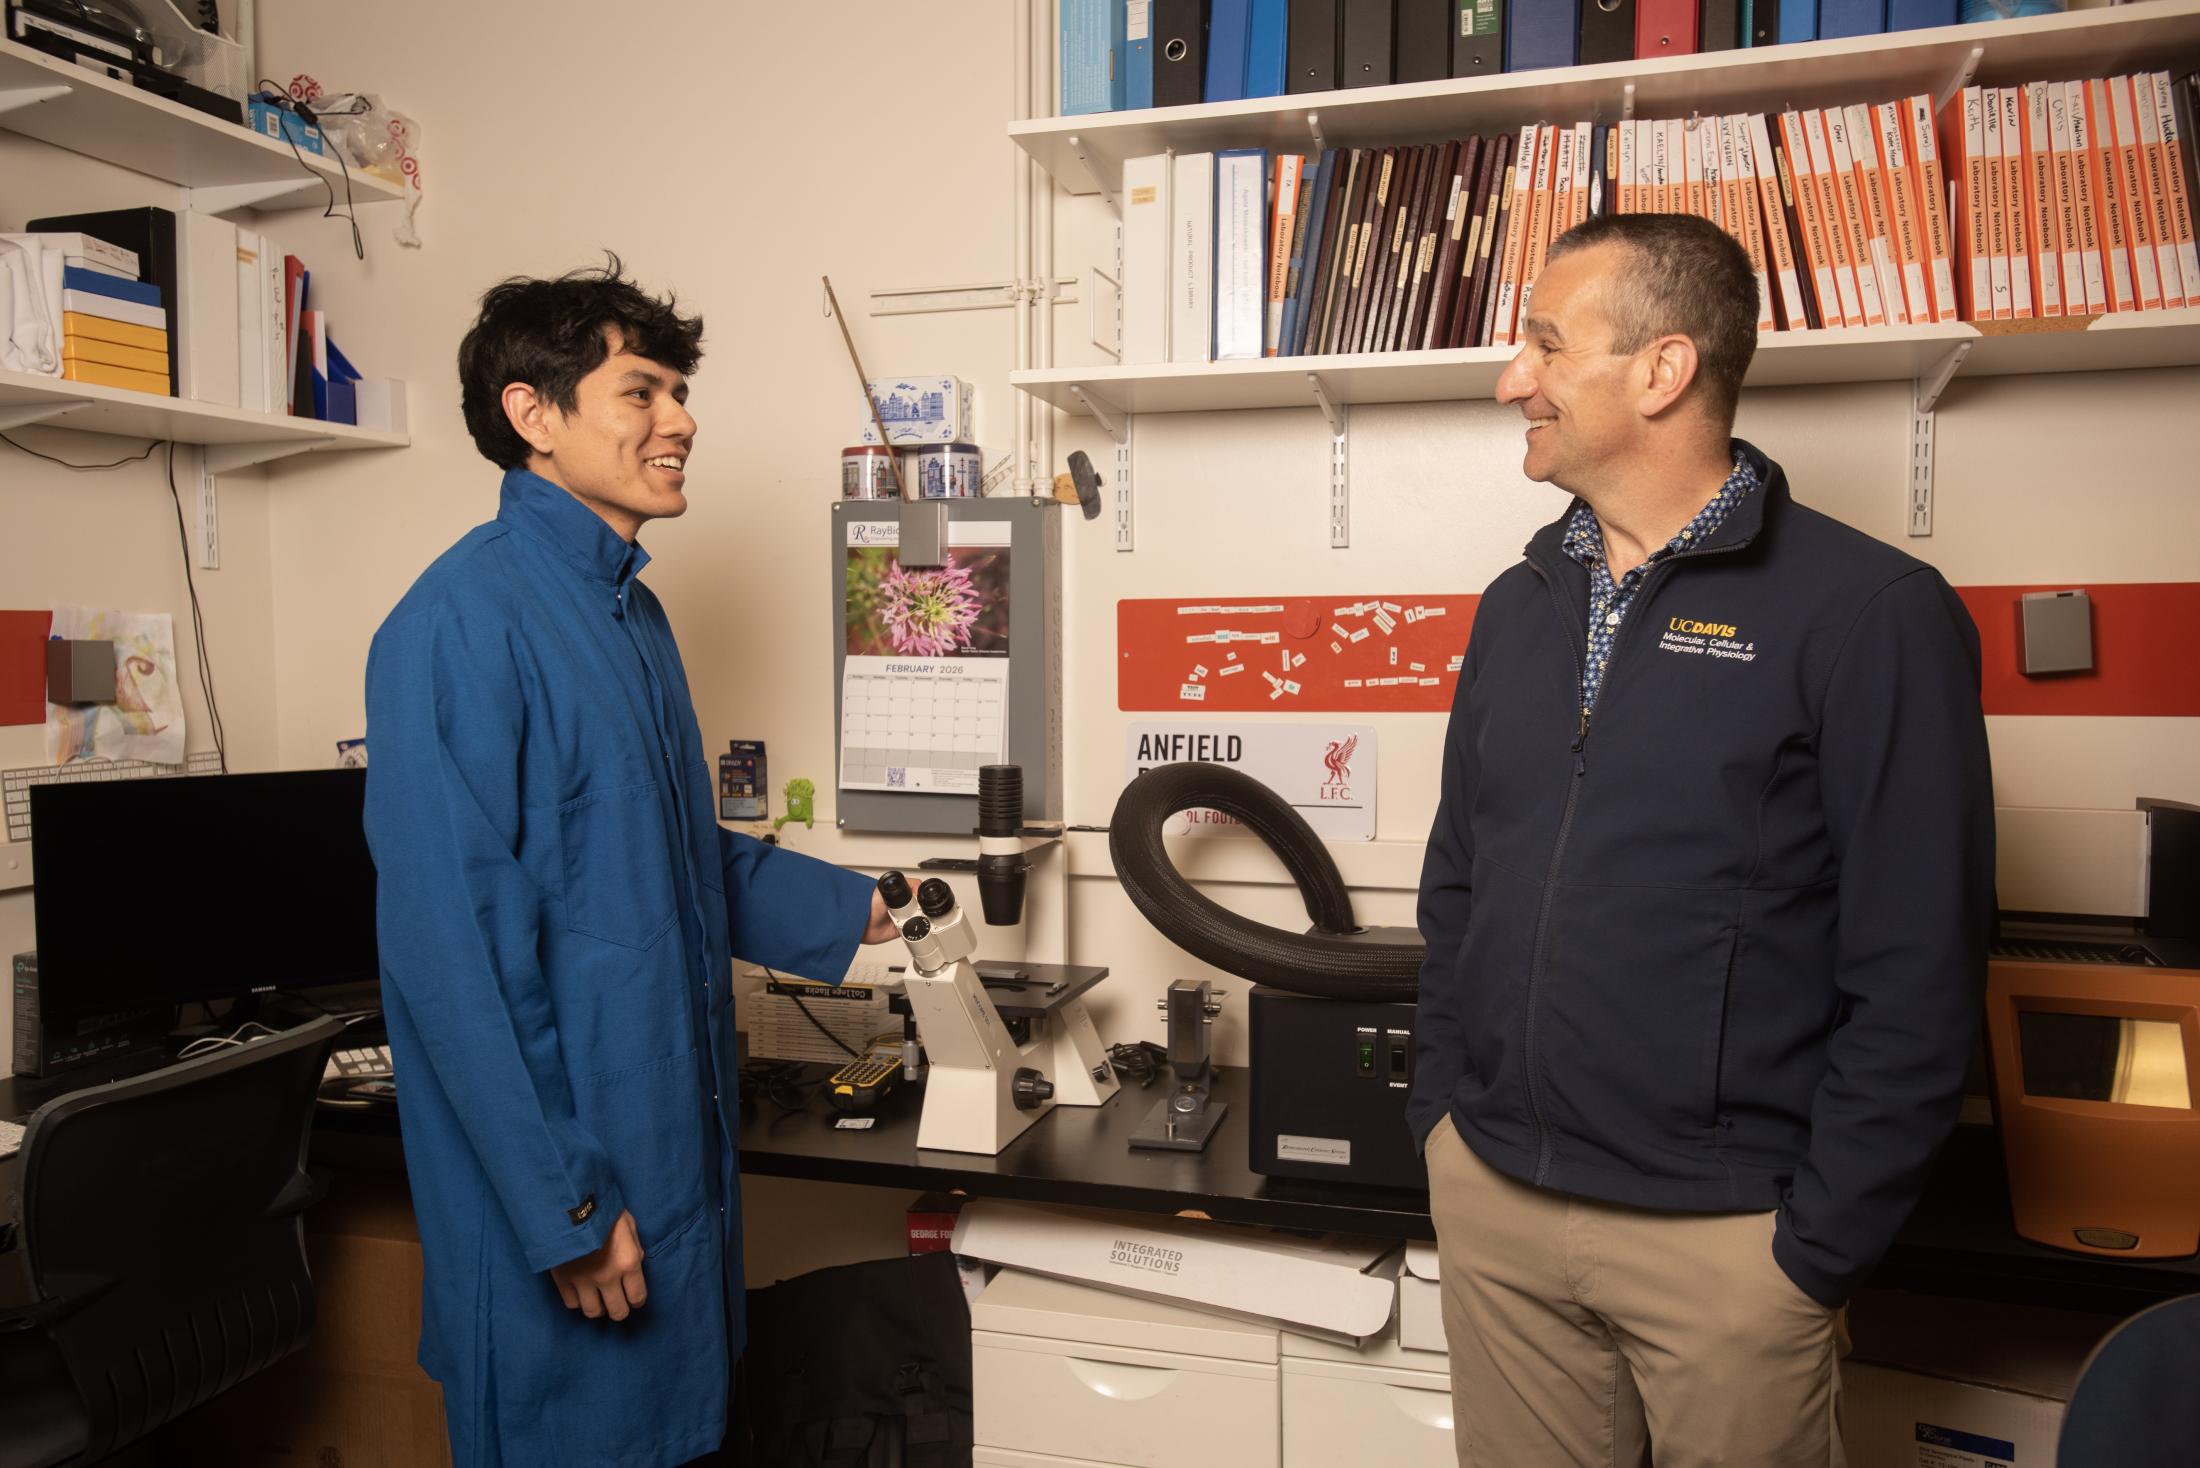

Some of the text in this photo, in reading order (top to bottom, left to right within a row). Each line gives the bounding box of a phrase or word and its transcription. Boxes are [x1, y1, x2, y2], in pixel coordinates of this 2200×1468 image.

[2052, 99, 2064, 132] Chris
[1728, 183, 1739, 228] Laboratory
[1745, 181, 1756, 227] Laboratory
[1766, 181, 1790, 267] Laboratory Notebook
[1801, 178, 1825, 265] Laboratory Notebook
[1822, 177, 1845, 264] Laboratory Notebook
[1843, 175, 1867, 263] Laboratory Notebook
[1868, 172, 1882, 218] Laboratory
[1894, 172, 1914, 261] Laboratory Notebook
[1925, 165, 1944, 256] Laboratory Notebook
[1972, 160, 1983, 254] Laboratory Notebook
[1990, 161, 1999, 207] Laboratory
[2010, 160, 2022, 253] Laboratory Notebook
[2037, 155, 2051, 249] Laboratory Notebook
[2059, 155, 2074, 249] Laboratory Notebook
[2077, 154, 2094, 248] Laboratory Notebook
[2103, 151, 2120, 245] Laboratory Notebook
[2126, 149, 2146, 243] Laboratory Notebook
[2149, 147, 2169, 242] Laboratory Notebook
[2168, 145, 2188, 240] Laboratory Notebook
[1273, 217, 1287, 299] Laboratory Notebook
[1506, 193, 1523, 283] Laboratory Notebook
[1526, 194, 1542, 281] Laboratory Notebook
[886, 664, 964, 674] FEBRUARY 2026
[1658, 640, 1756, 662] Integrative Physiology
[1662, 631, 1754, 651] Molecular, Cellular &
[1137, 734, 1242, 762] ANFIELD
[1320, 787, 1353, 801] L.F.C.
[804, 986, 866, 998] College Hacks
[1386, 1028, 1411, 1036] MANUAL
[911, 1229, 939, 1239] GEORGE
[1110, 1250, 1181, 1272] SOLUTIONS
[1113, 1239, 1183, 1262] INTEGRATED
